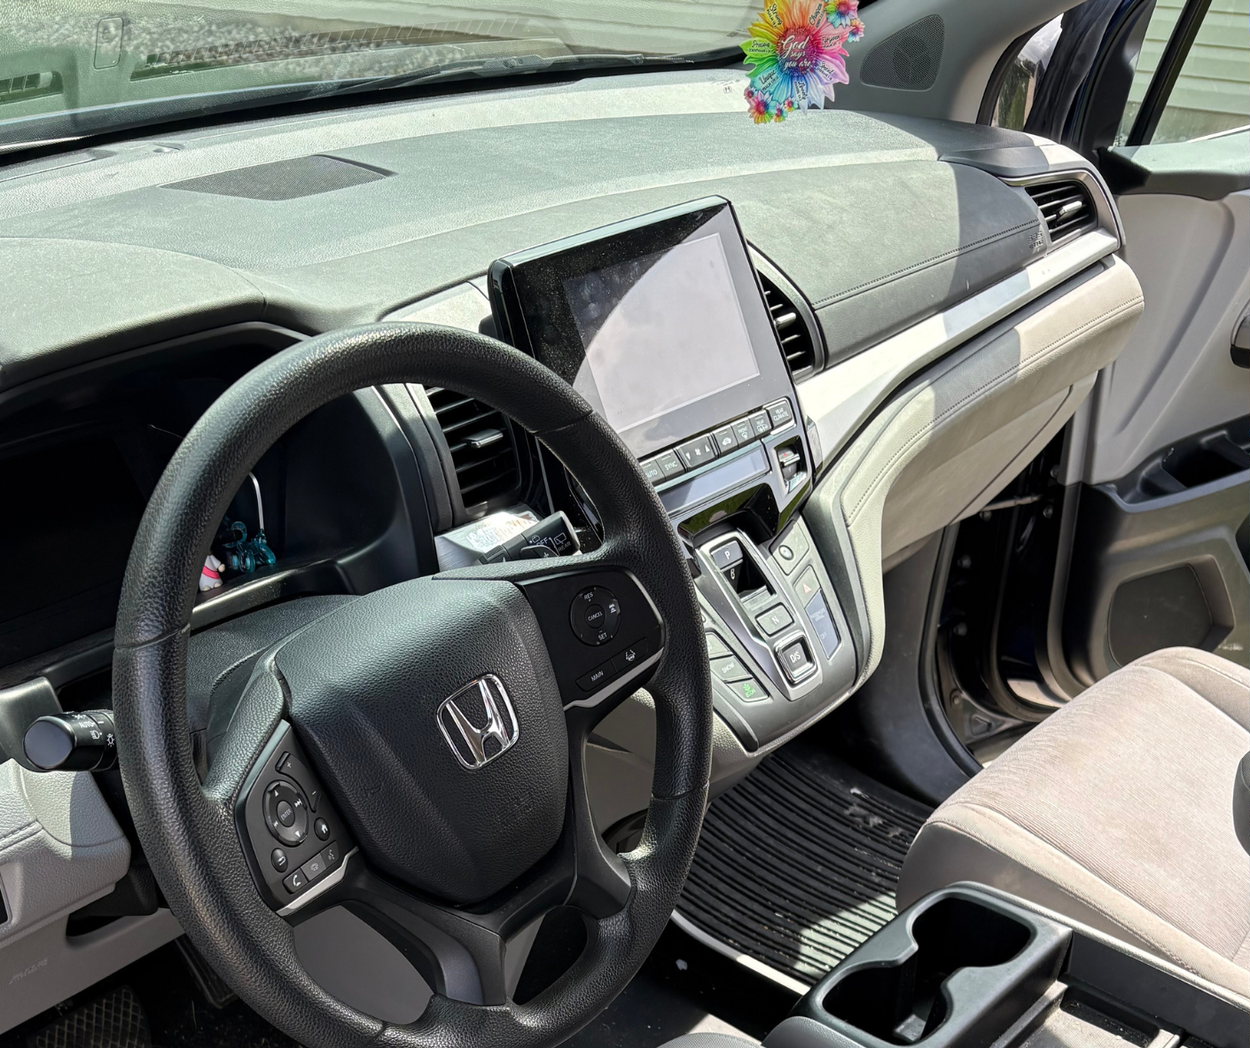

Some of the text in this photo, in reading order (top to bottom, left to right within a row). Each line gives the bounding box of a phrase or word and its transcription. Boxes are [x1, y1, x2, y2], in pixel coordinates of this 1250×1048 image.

[781, 35, 810, 59] God
[791, 51, 806, 60] says
[784, 59, 811, 70] you are
[724, 550, 731, 560] P
[584, 592, 594, 600] RES
[588, 611, 603, 621] CANCEL
[771, 615, 780, 625] N
[598, 632, 607, 640] SET
[721, 662, 735, 673] SNOW
[590, 670, 604, 682] MAIN
